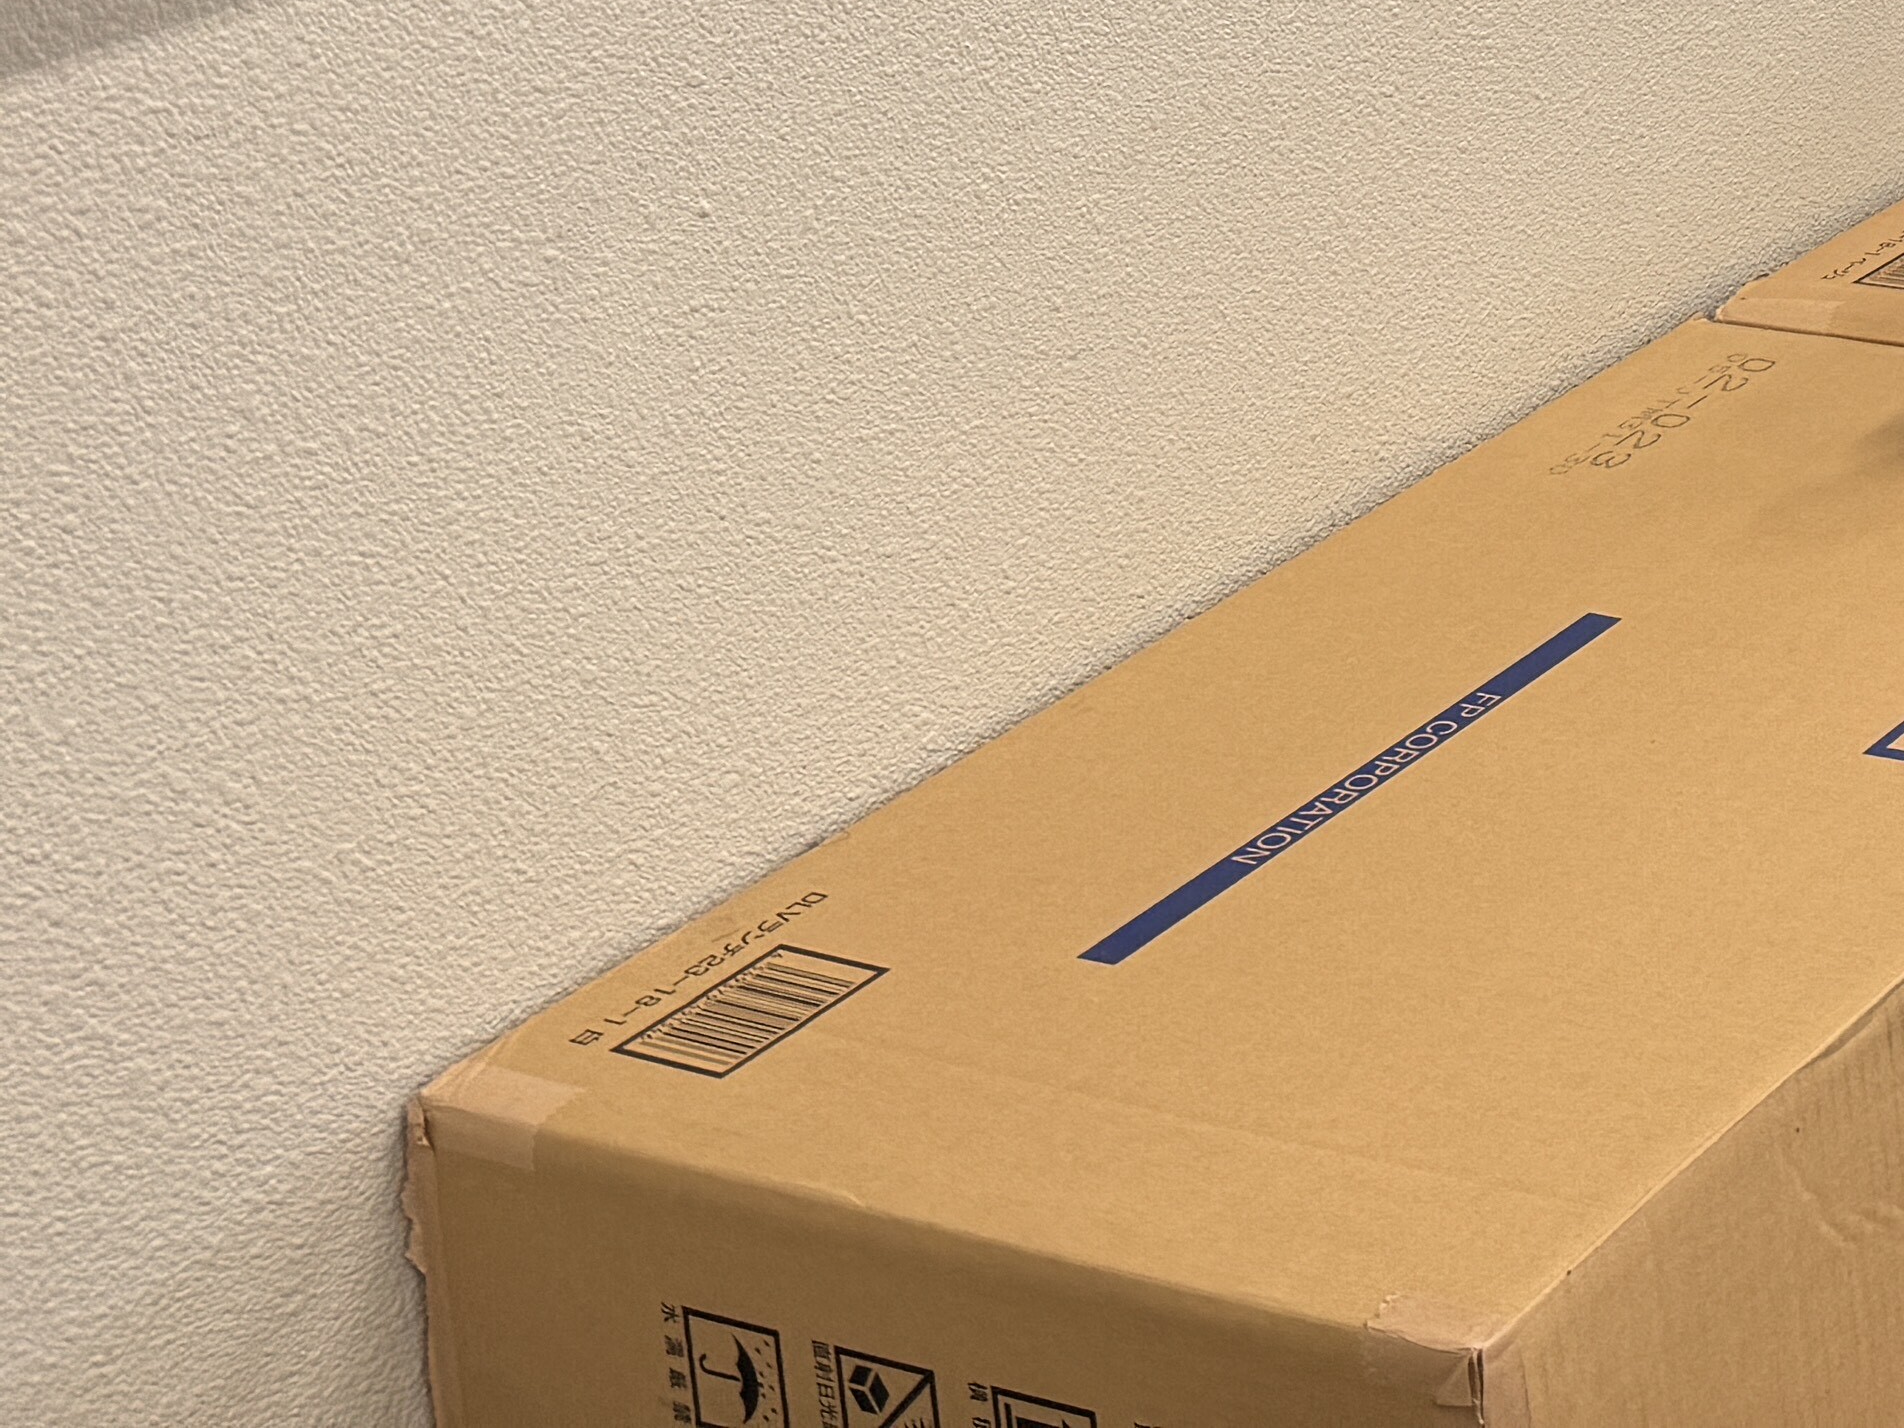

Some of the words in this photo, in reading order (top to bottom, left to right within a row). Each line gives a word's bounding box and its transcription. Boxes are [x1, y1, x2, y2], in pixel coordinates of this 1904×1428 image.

[1596, 356, 1775, 470] 02-023
[1459, 691, 1502, 720] FP
[1231, 718, 1457, 866] CORPORATION
[568, 1026, 604, 1047] 白
